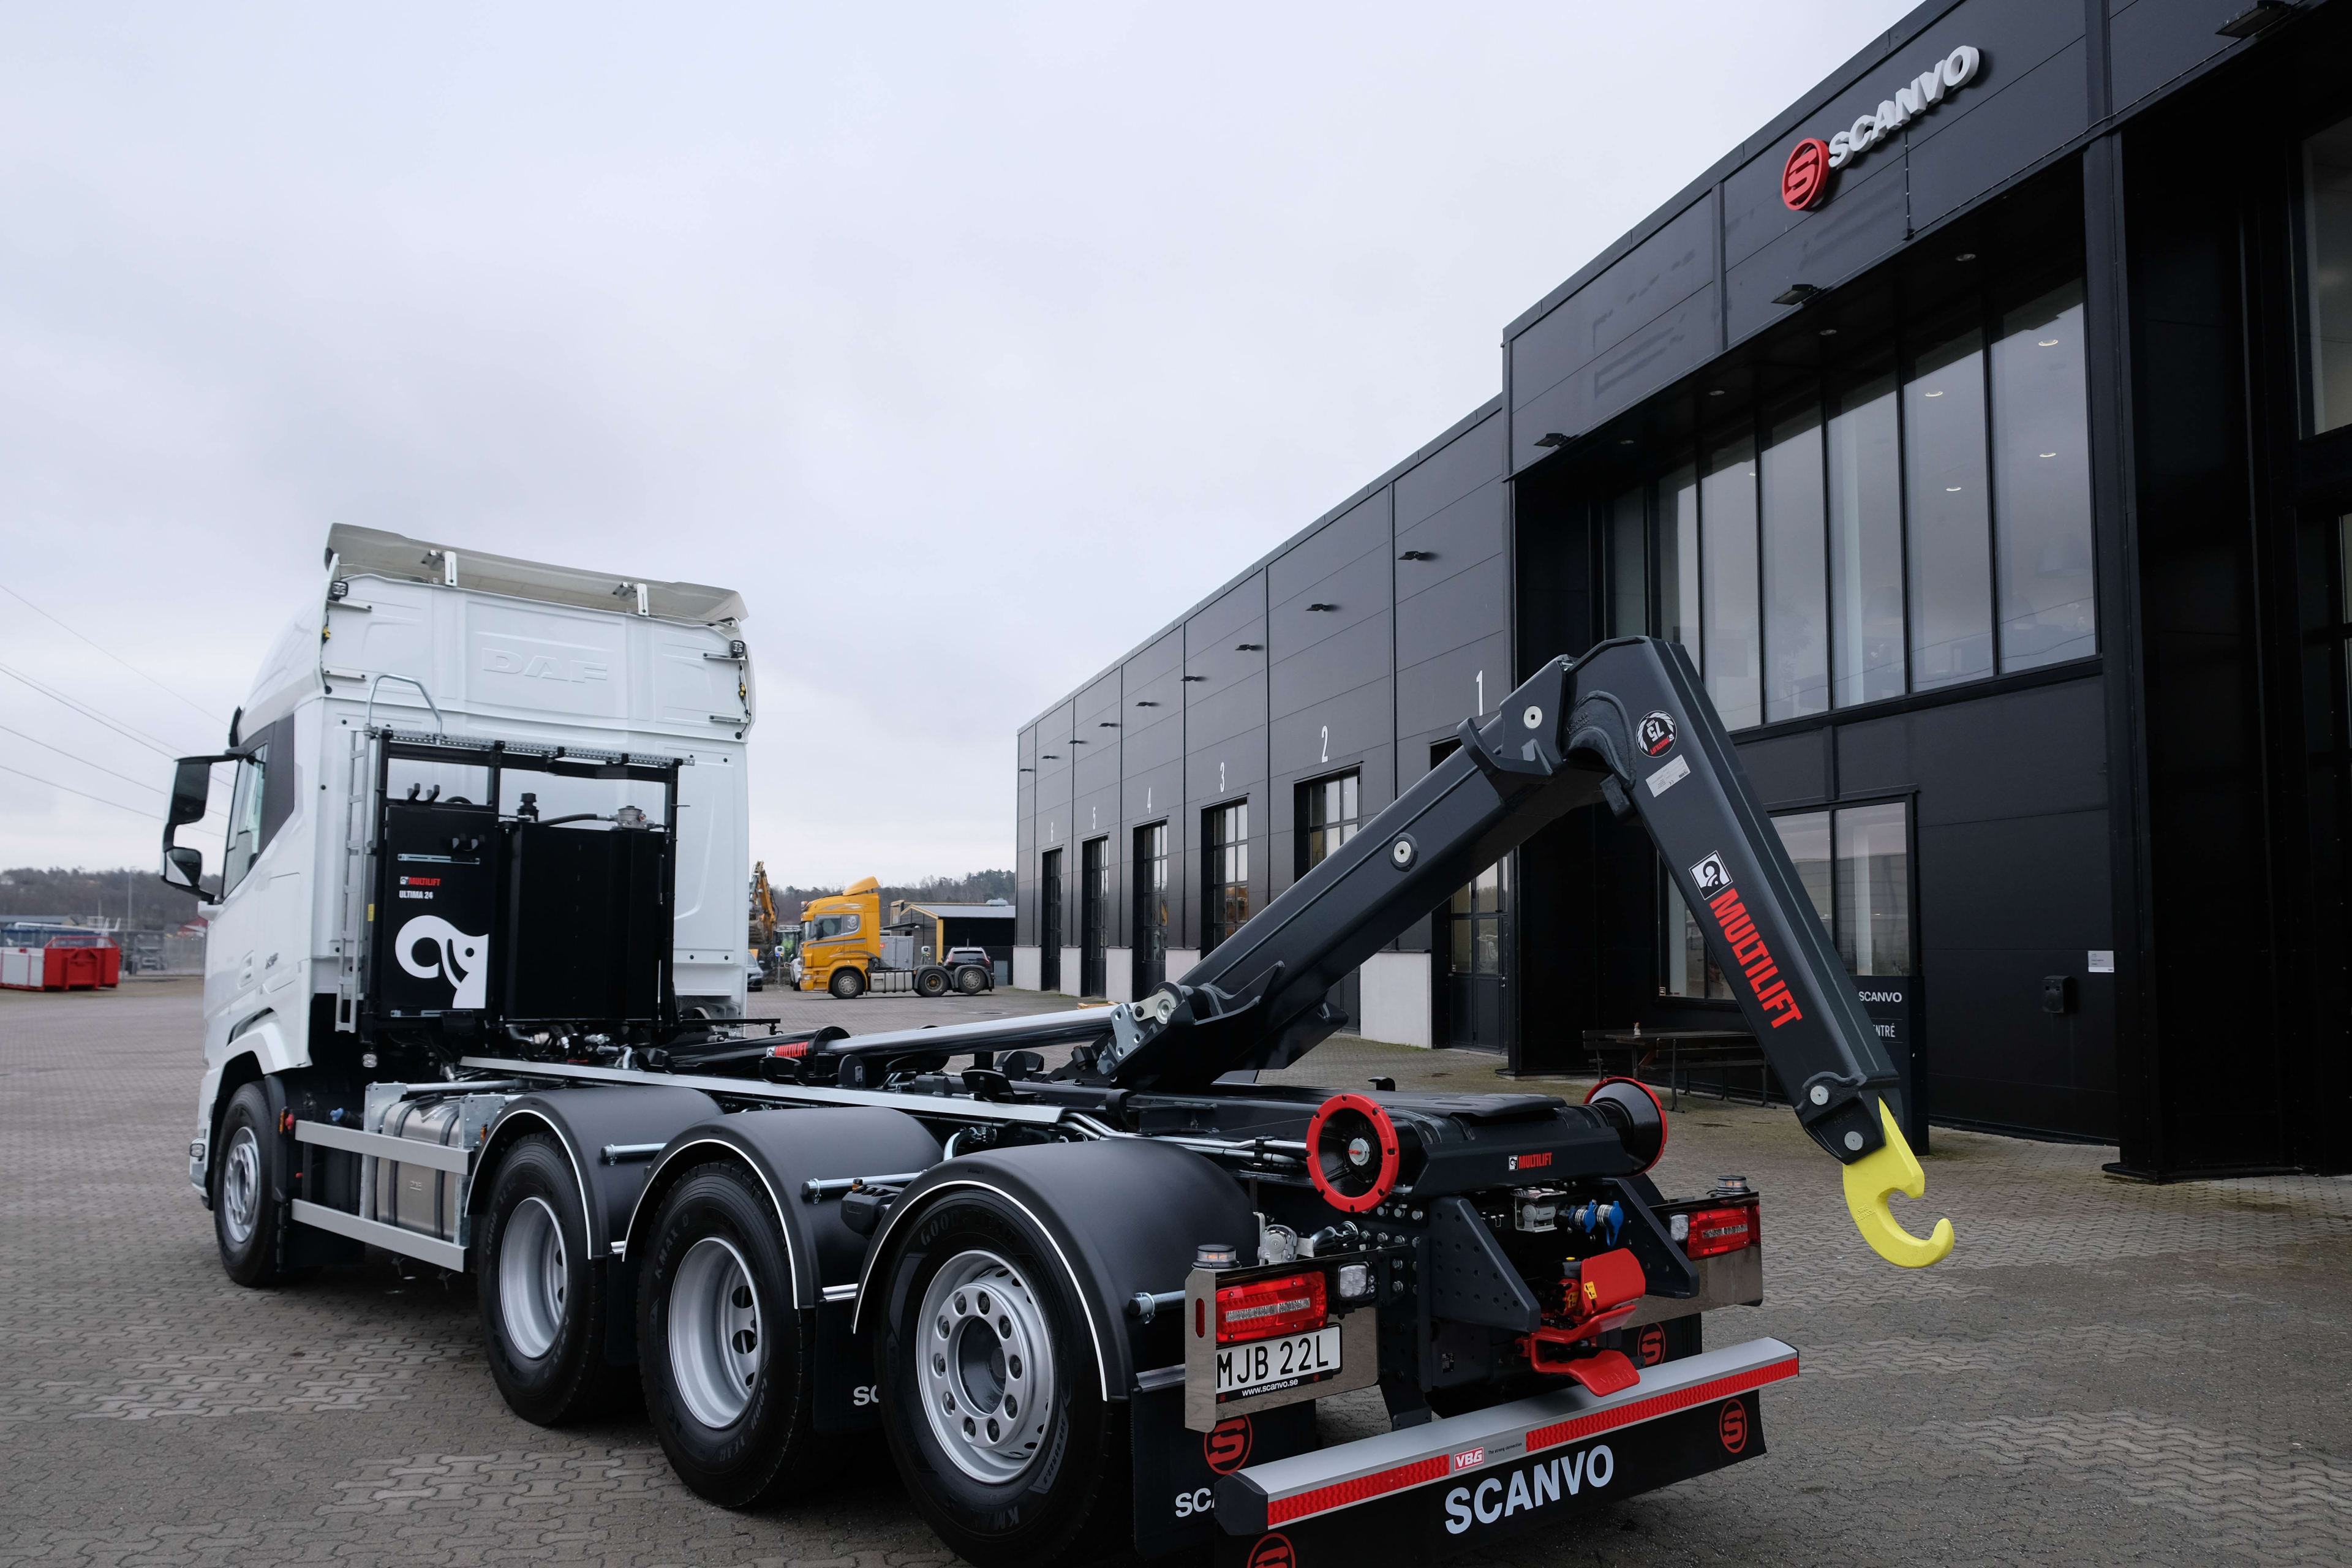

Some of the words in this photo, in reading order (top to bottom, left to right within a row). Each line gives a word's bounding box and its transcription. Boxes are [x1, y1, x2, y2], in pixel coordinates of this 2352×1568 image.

[1828, 45, 1979, 168] SCANVO
[482, 647, 607, 683] DAF
[1476, 670, 1483, 716] 1
[1646, 722, 1665, 742] 75
[1322, 726, 1328, 763] 2
[1649, 737, 1670, 755] MULTILIFT
[1220, 762, 1225, 793] 3
[1147, 787, 1152, 813] 4
[1093, 807, 1096, 830] 5
[1050, 822, 1054, 842] 6
[409, 877, 441, 886] MULTILIFT
[399, 890, 423, 899] ULTIMA
[1709, 888, 1803, 1028] MULTILIFT
[1858, 991, 1902, 1003] SCANVO
[1873, 1022, 1896, 1038] NTRÉ
[775, 1041, 809, 1058] MULTILIFT
[1519, 1152, 1552, 1169] MULTILIFT
[1216, 1346, 1268, 1389] MJB
[1280, 1335, 1329, 1375] 22L
[1242, 1378, 1298, 1396] www.scanvo.se
[1456, 1449, 1483, 1468] VBG
[1505, 1442, 1522, 1450] connection
[1445, 1444, 1614, 1534] SCANVO
